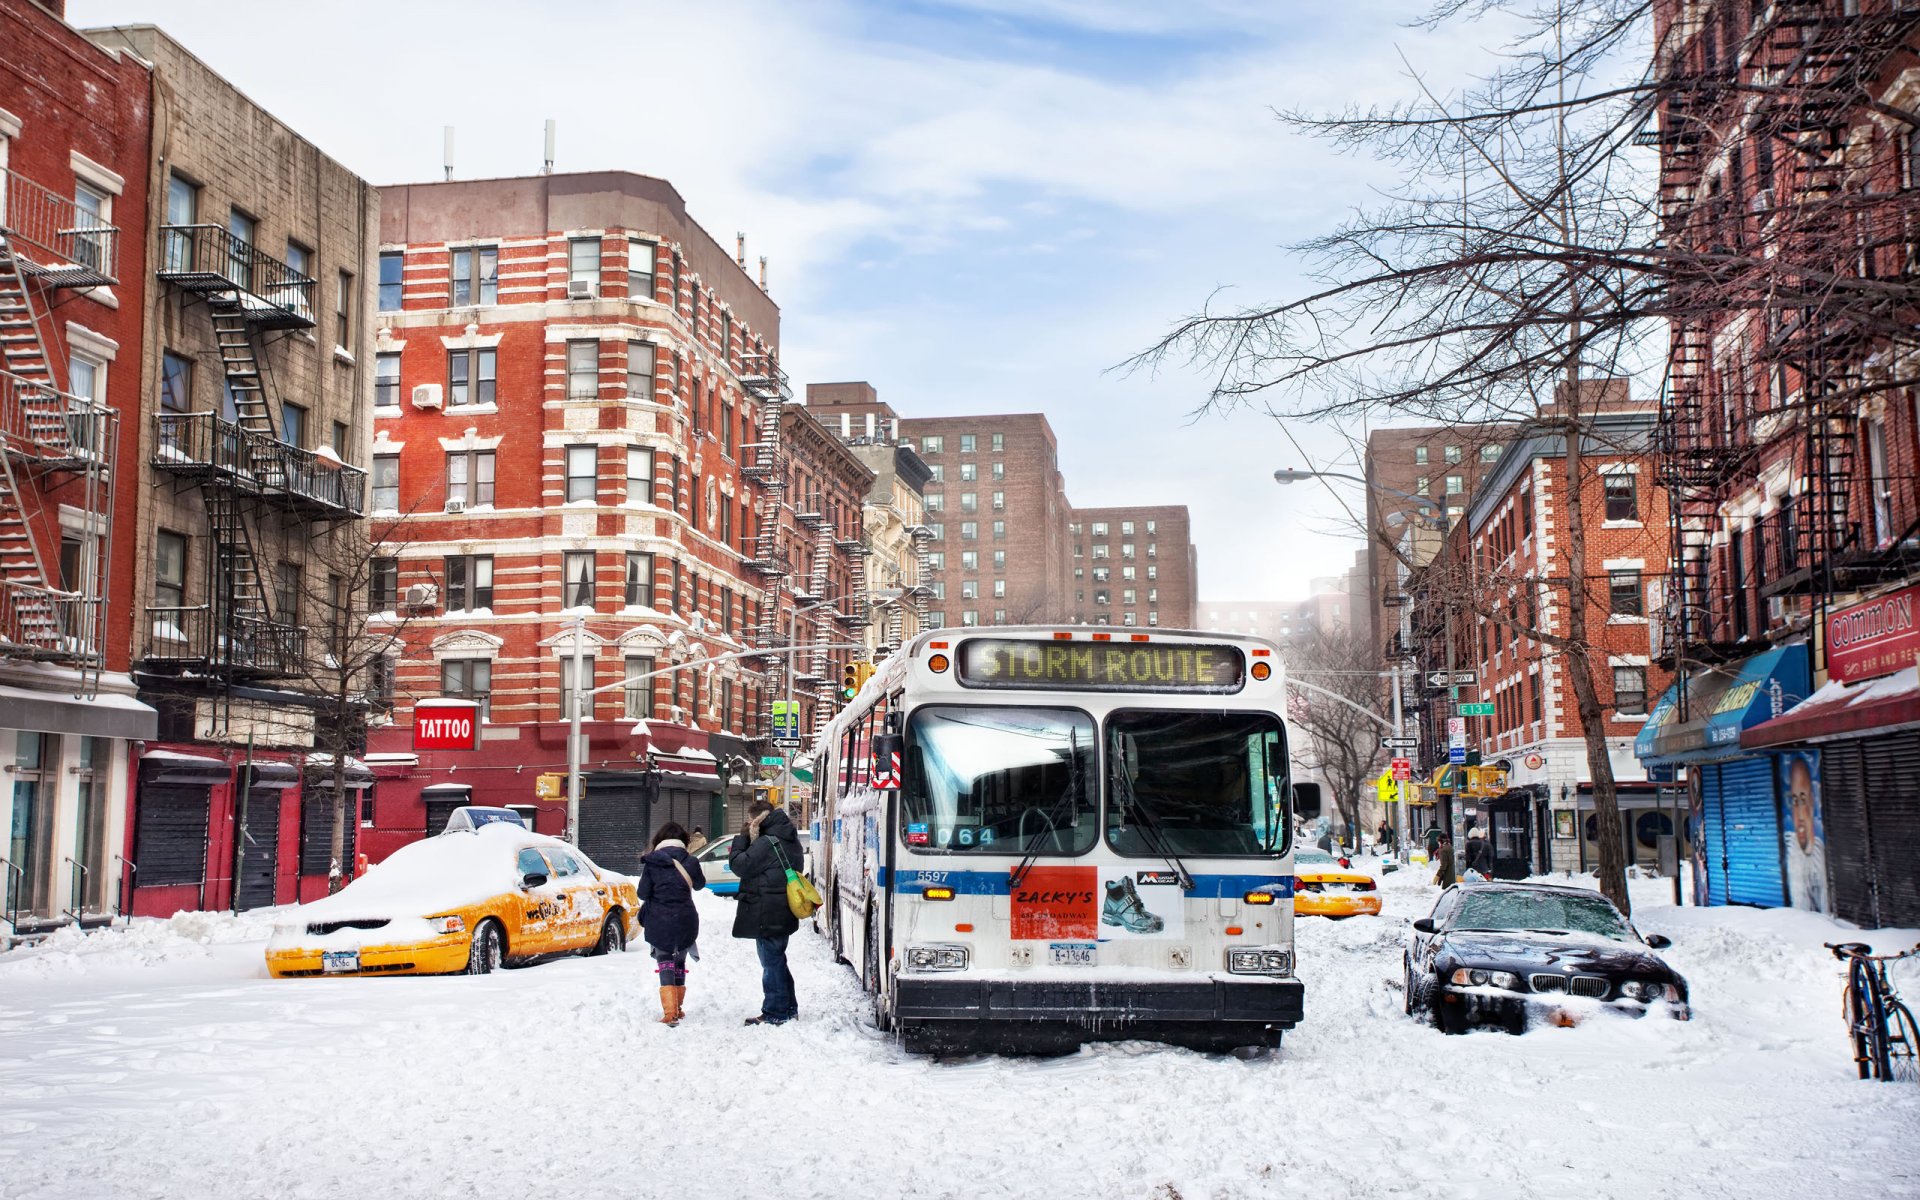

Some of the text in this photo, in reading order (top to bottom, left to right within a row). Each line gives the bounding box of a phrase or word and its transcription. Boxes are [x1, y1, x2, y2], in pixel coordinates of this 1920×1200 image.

[1831, 594, 1912, 649] COMMON
[980, 644, 1215, 682] STORM ROUTE
[1863, 657, 1877, 672] BAR
[1881, 652, 1897, 667] AND
[1433, 675, 1448, 683] ONE
[1461, 705, 1467, 714] E
[1470, 705, 1482, 714] 13
[419, 718, 470, 738] TATTOO
[917, 871, 949, 882] 5597
[1016, 891, 1093, 904] ZACKY'S
